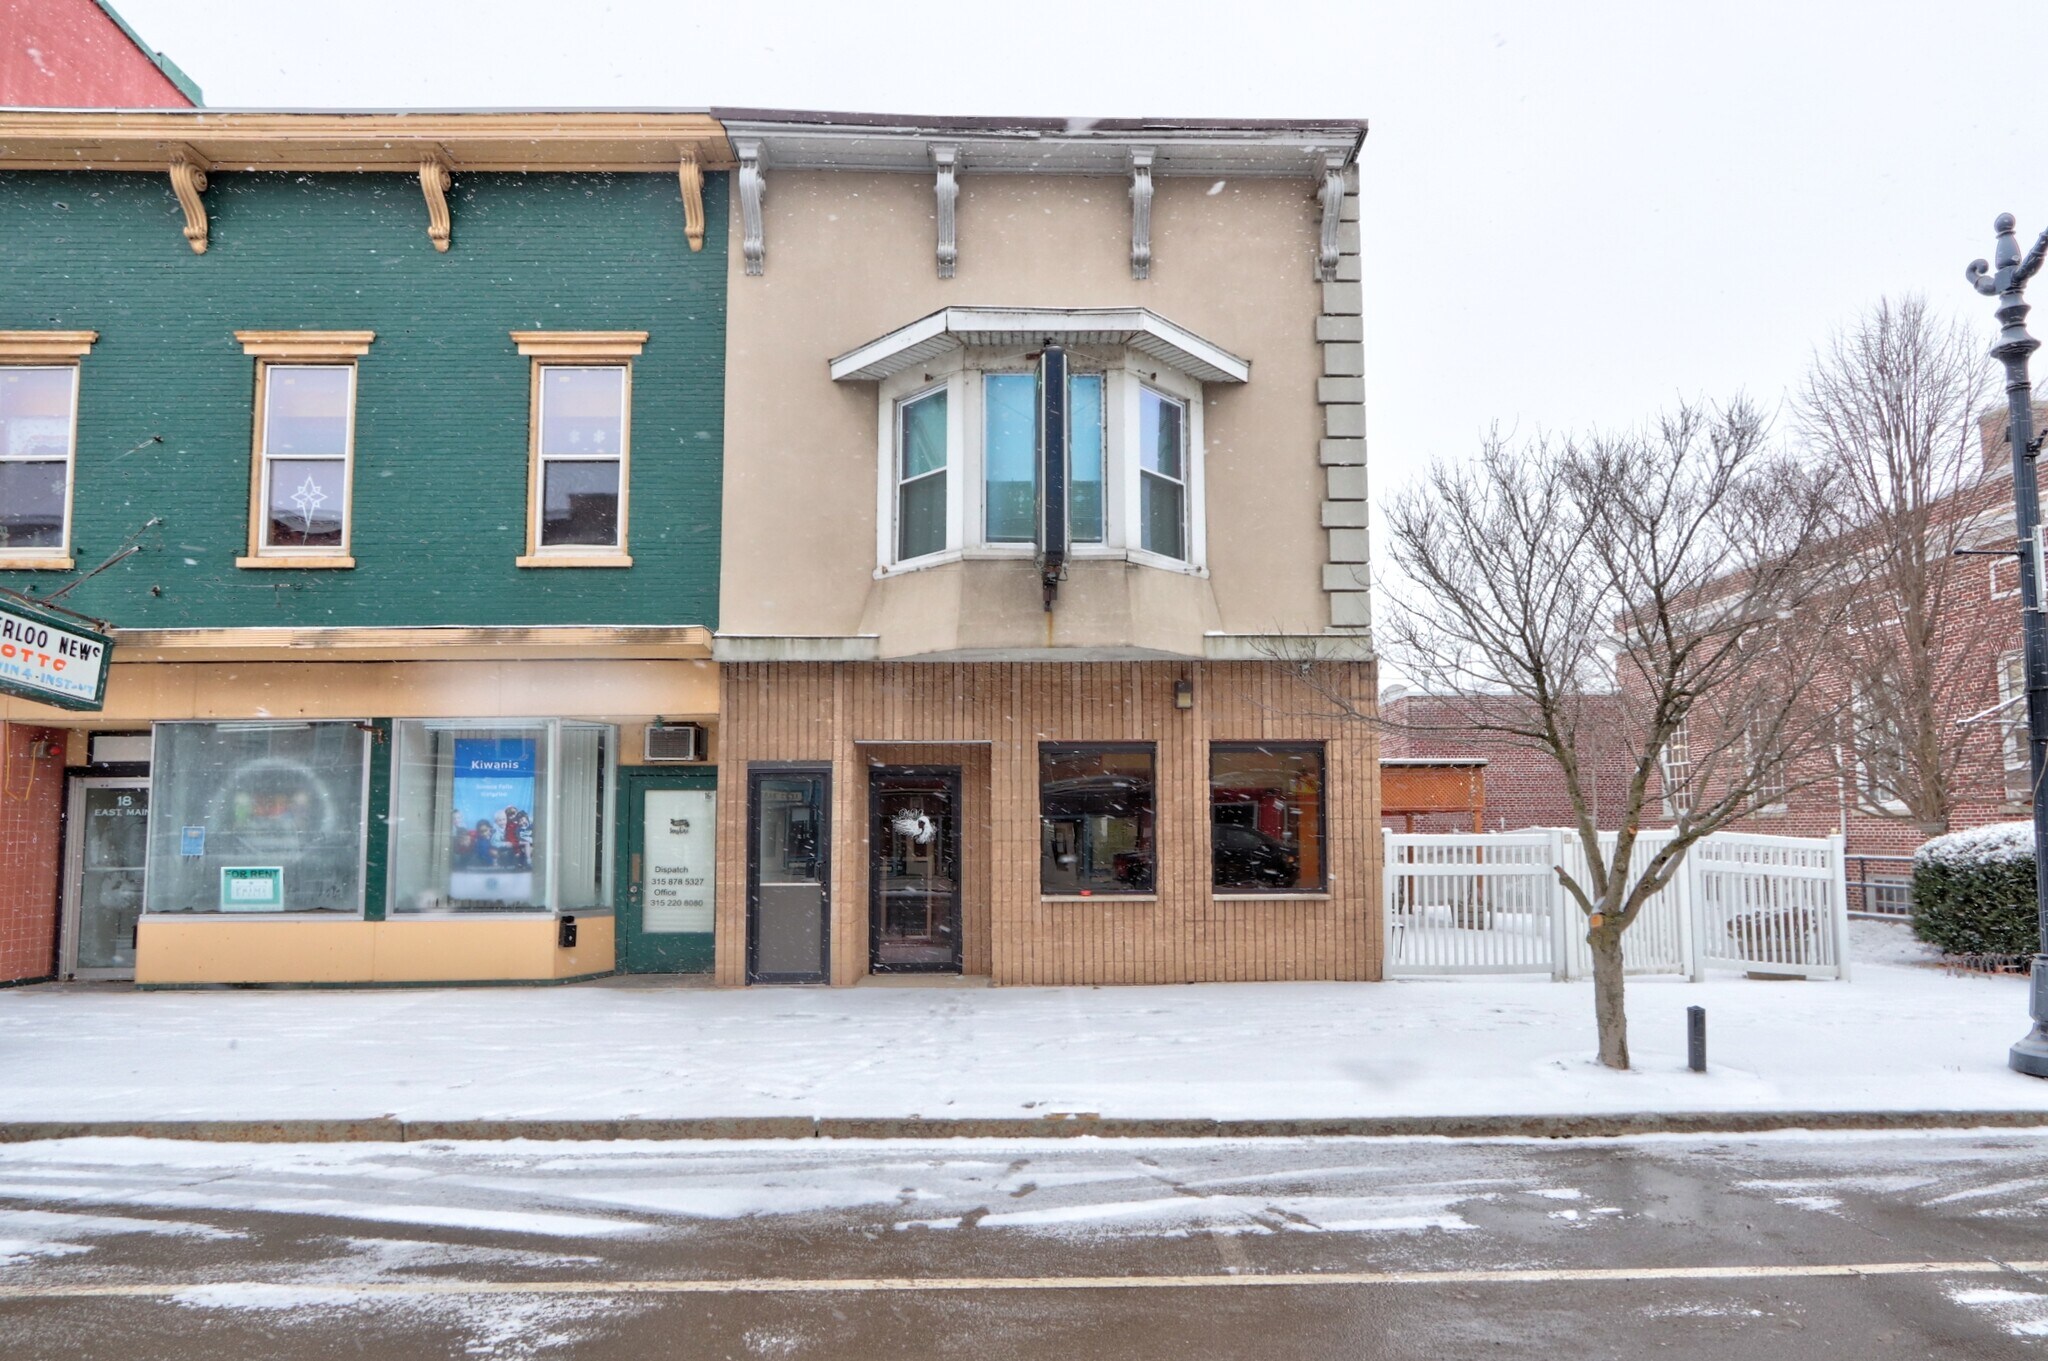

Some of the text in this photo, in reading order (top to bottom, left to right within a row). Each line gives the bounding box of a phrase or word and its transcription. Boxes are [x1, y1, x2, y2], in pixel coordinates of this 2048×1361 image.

[0, 617, 48, 648] RLOO
[471, 760, 519, 769] Kiwanis
[117, 796, 132, 806] 18
[224, 869, 279, 878] FOR RENT
[654, 865, 689, 874] Dispatch
[651, 878, 704, 886] 315 878 5327
[654, 888, 677, 896] Office
[650, 899, 666, 907] 315
[667, 899, 682, 907] 220
